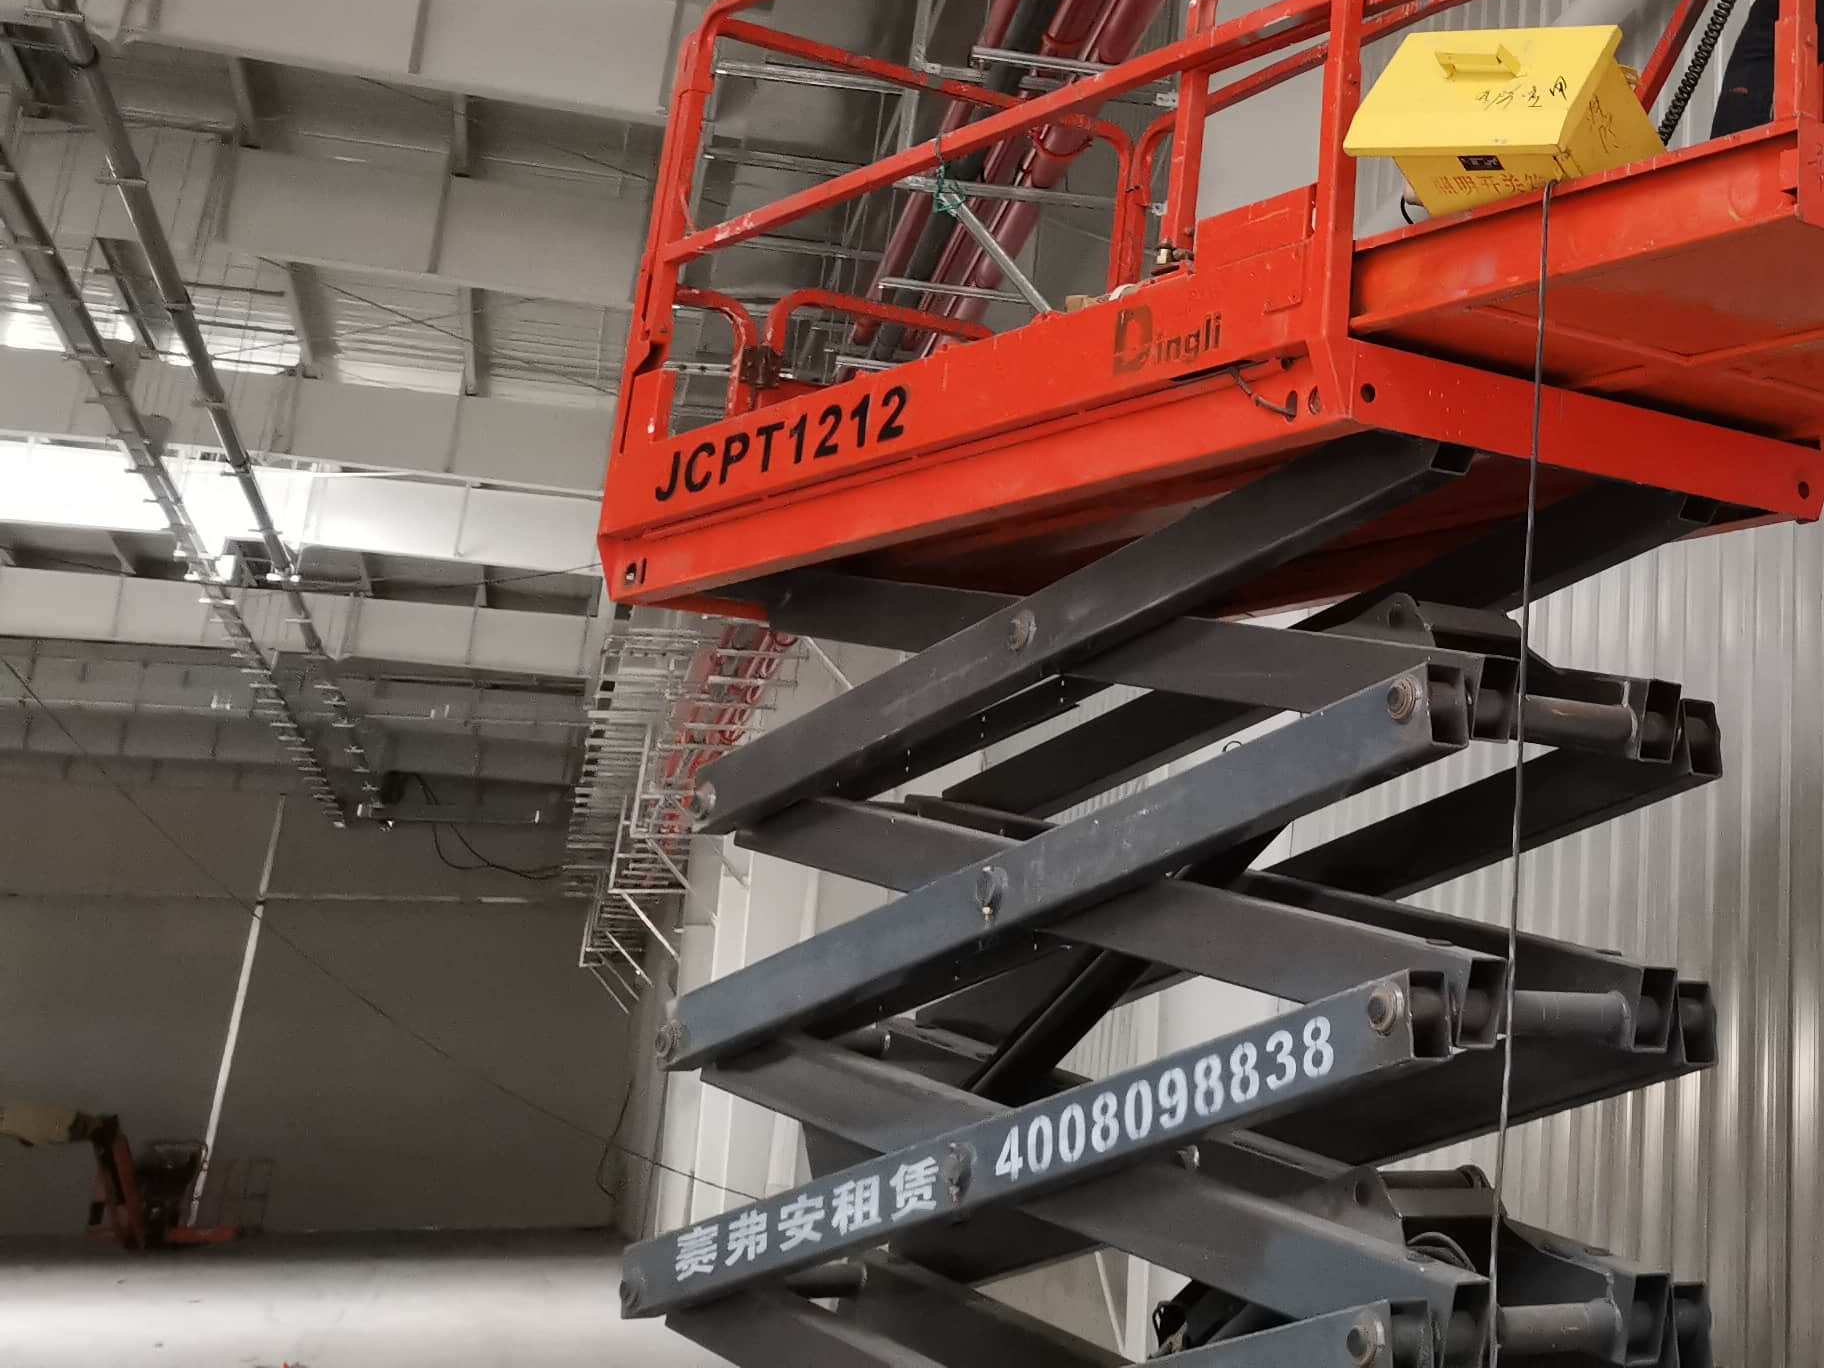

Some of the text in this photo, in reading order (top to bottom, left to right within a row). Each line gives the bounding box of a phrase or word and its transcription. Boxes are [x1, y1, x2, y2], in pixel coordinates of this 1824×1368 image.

[1113, 304, 1222, 376] Dingli
[655, 385, 908, 502] JCPT1212
[994, 1016, 1335, 1182] 4008098838
